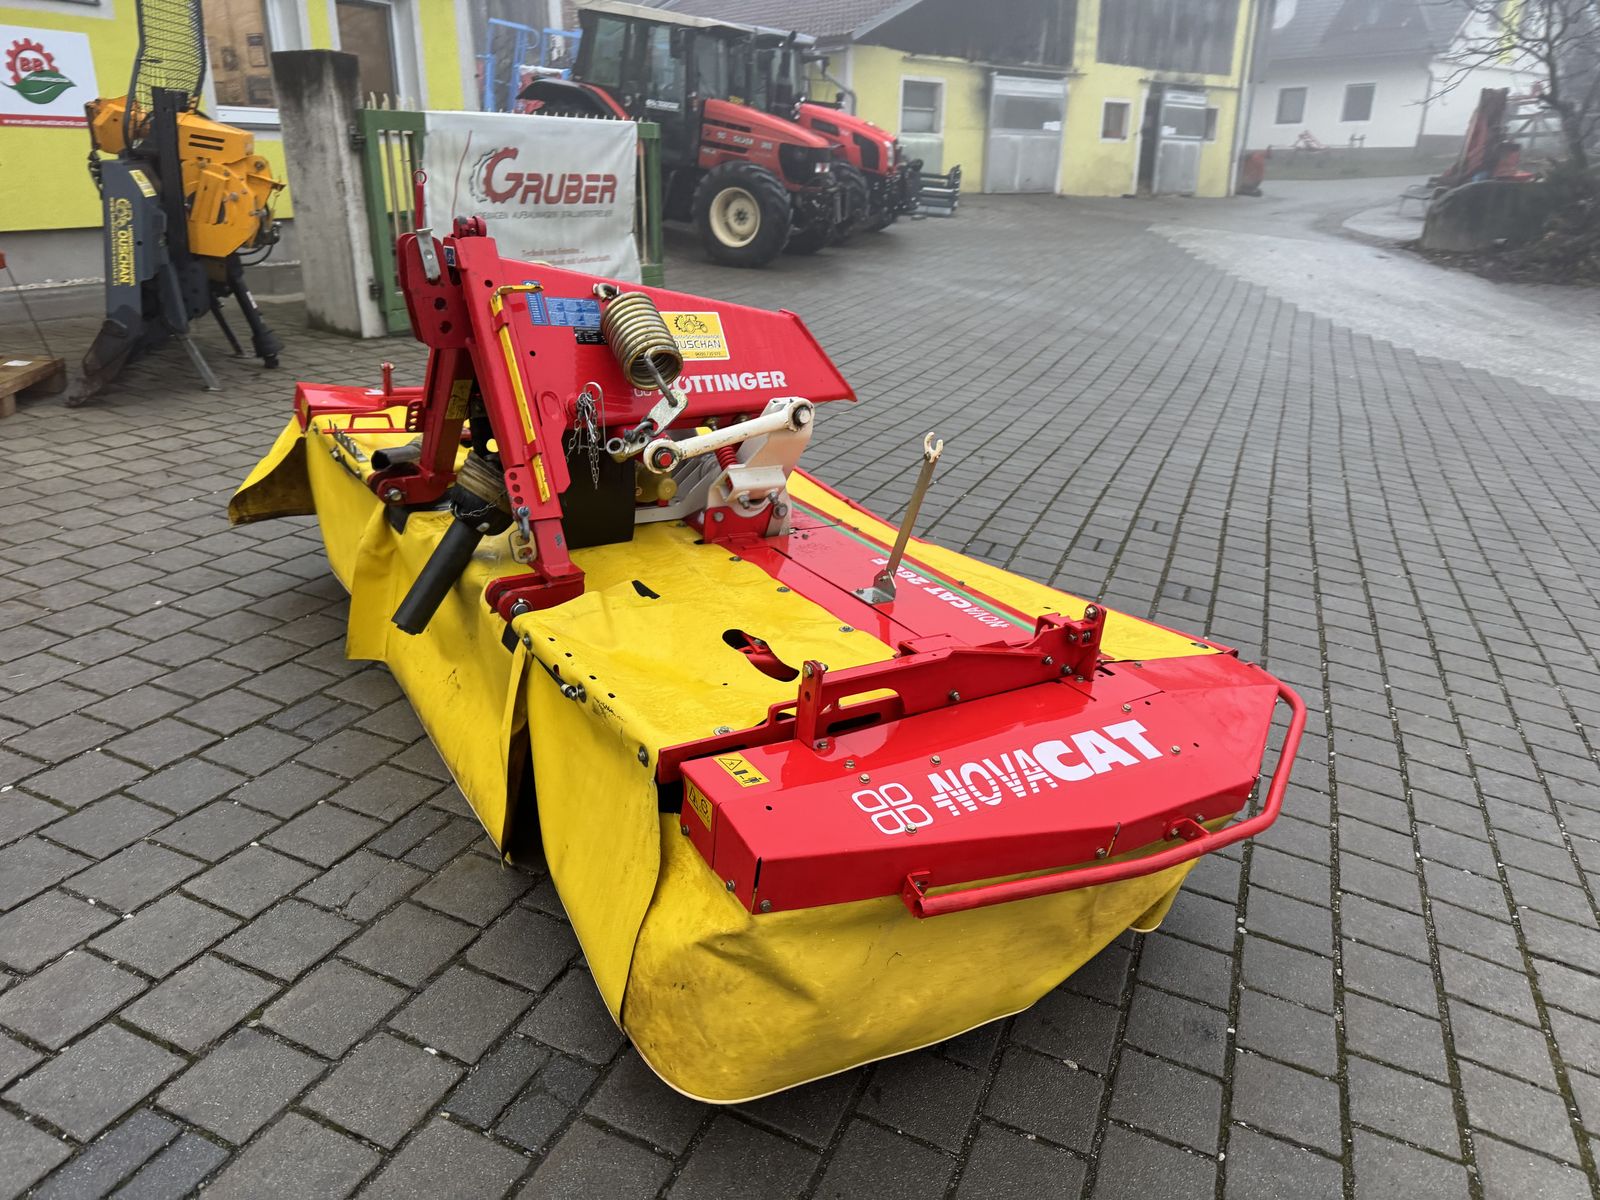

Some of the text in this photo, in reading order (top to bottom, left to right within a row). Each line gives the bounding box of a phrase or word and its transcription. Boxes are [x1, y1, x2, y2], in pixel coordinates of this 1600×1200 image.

[482, 146, 617, 205] GRUBER
[658, 370, 788, 395] ÖTTINGER
[923, 585, 1010, 628] NOVACAT
[927, 719, 1164, 817] NOVACAT
